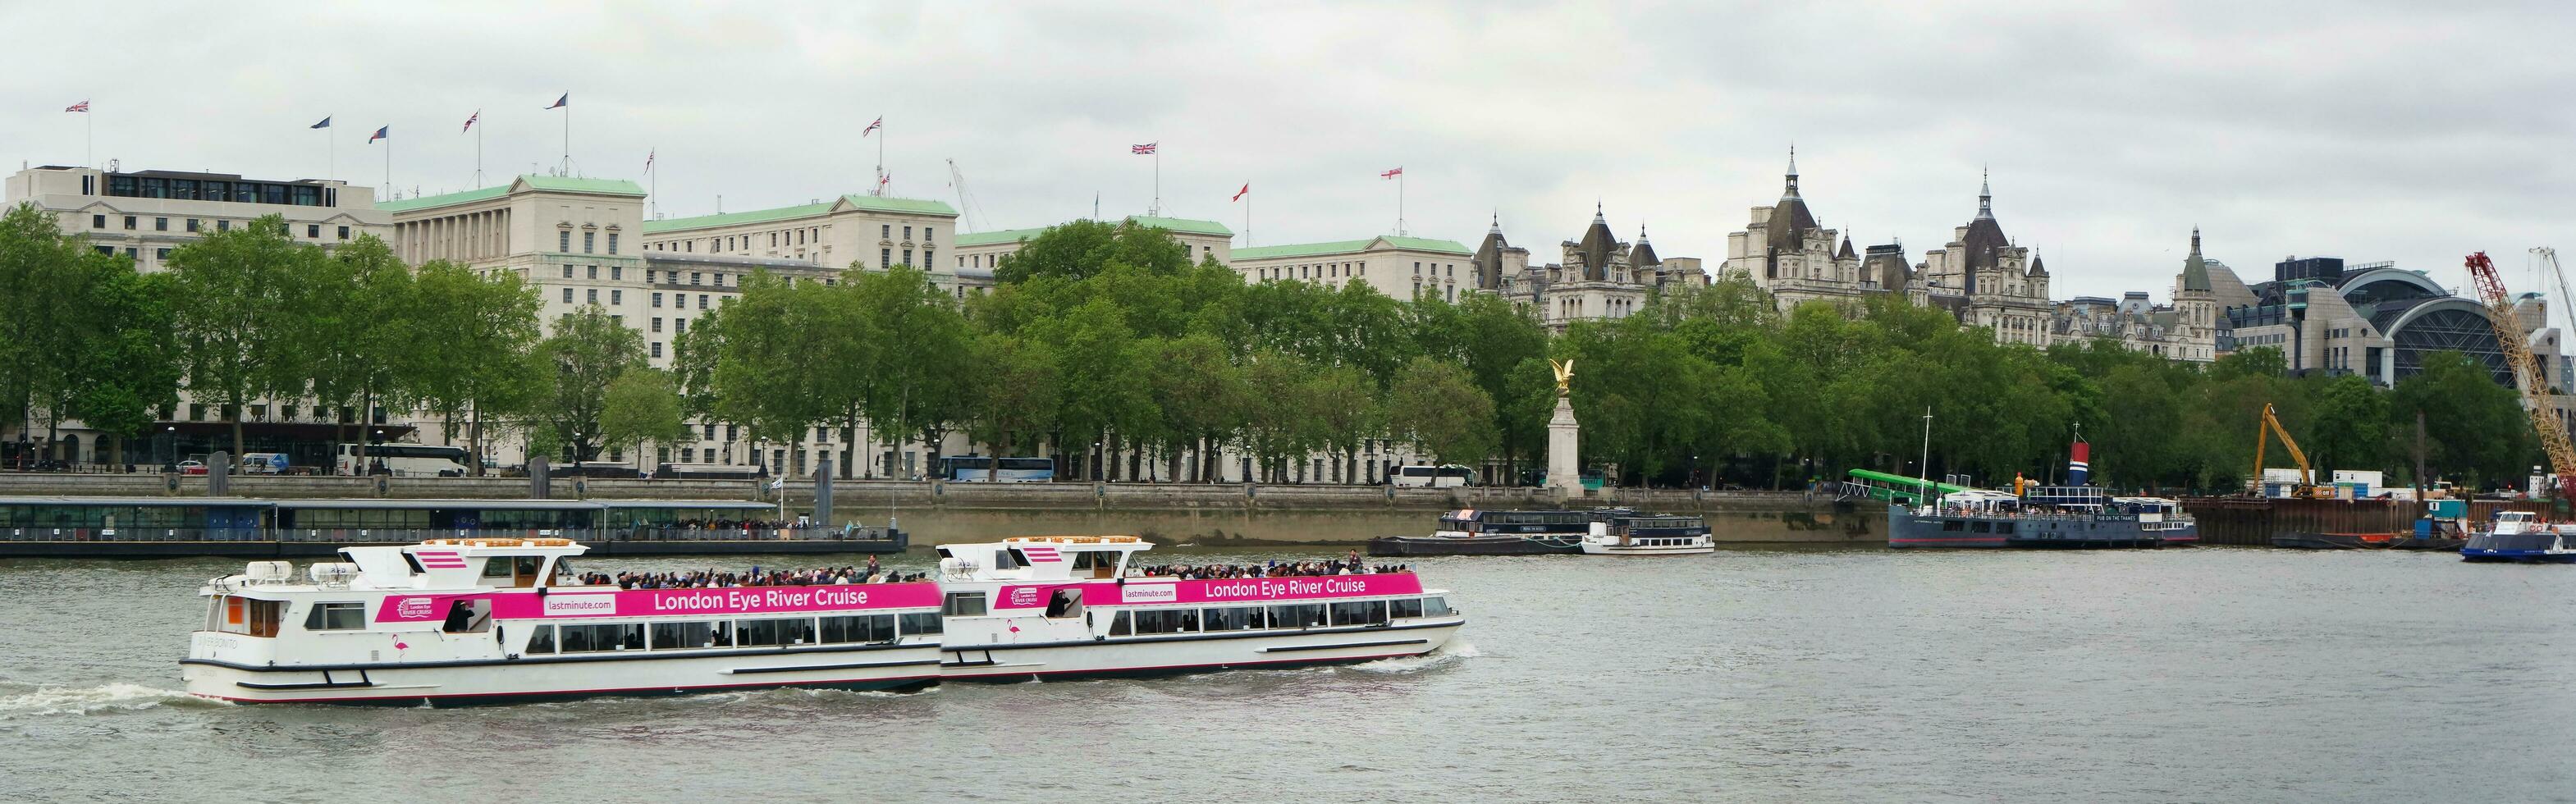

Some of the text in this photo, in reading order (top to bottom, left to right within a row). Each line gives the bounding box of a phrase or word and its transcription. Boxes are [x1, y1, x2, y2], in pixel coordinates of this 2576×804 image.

[1125, 589, 1173, 597] lastminute.com
[1206, 578, 1366, 598] London Eye River Cruise
[548, 601, 611, 610] lastminute.com
[654, 587, 867, 611] London Eye River Cruise
